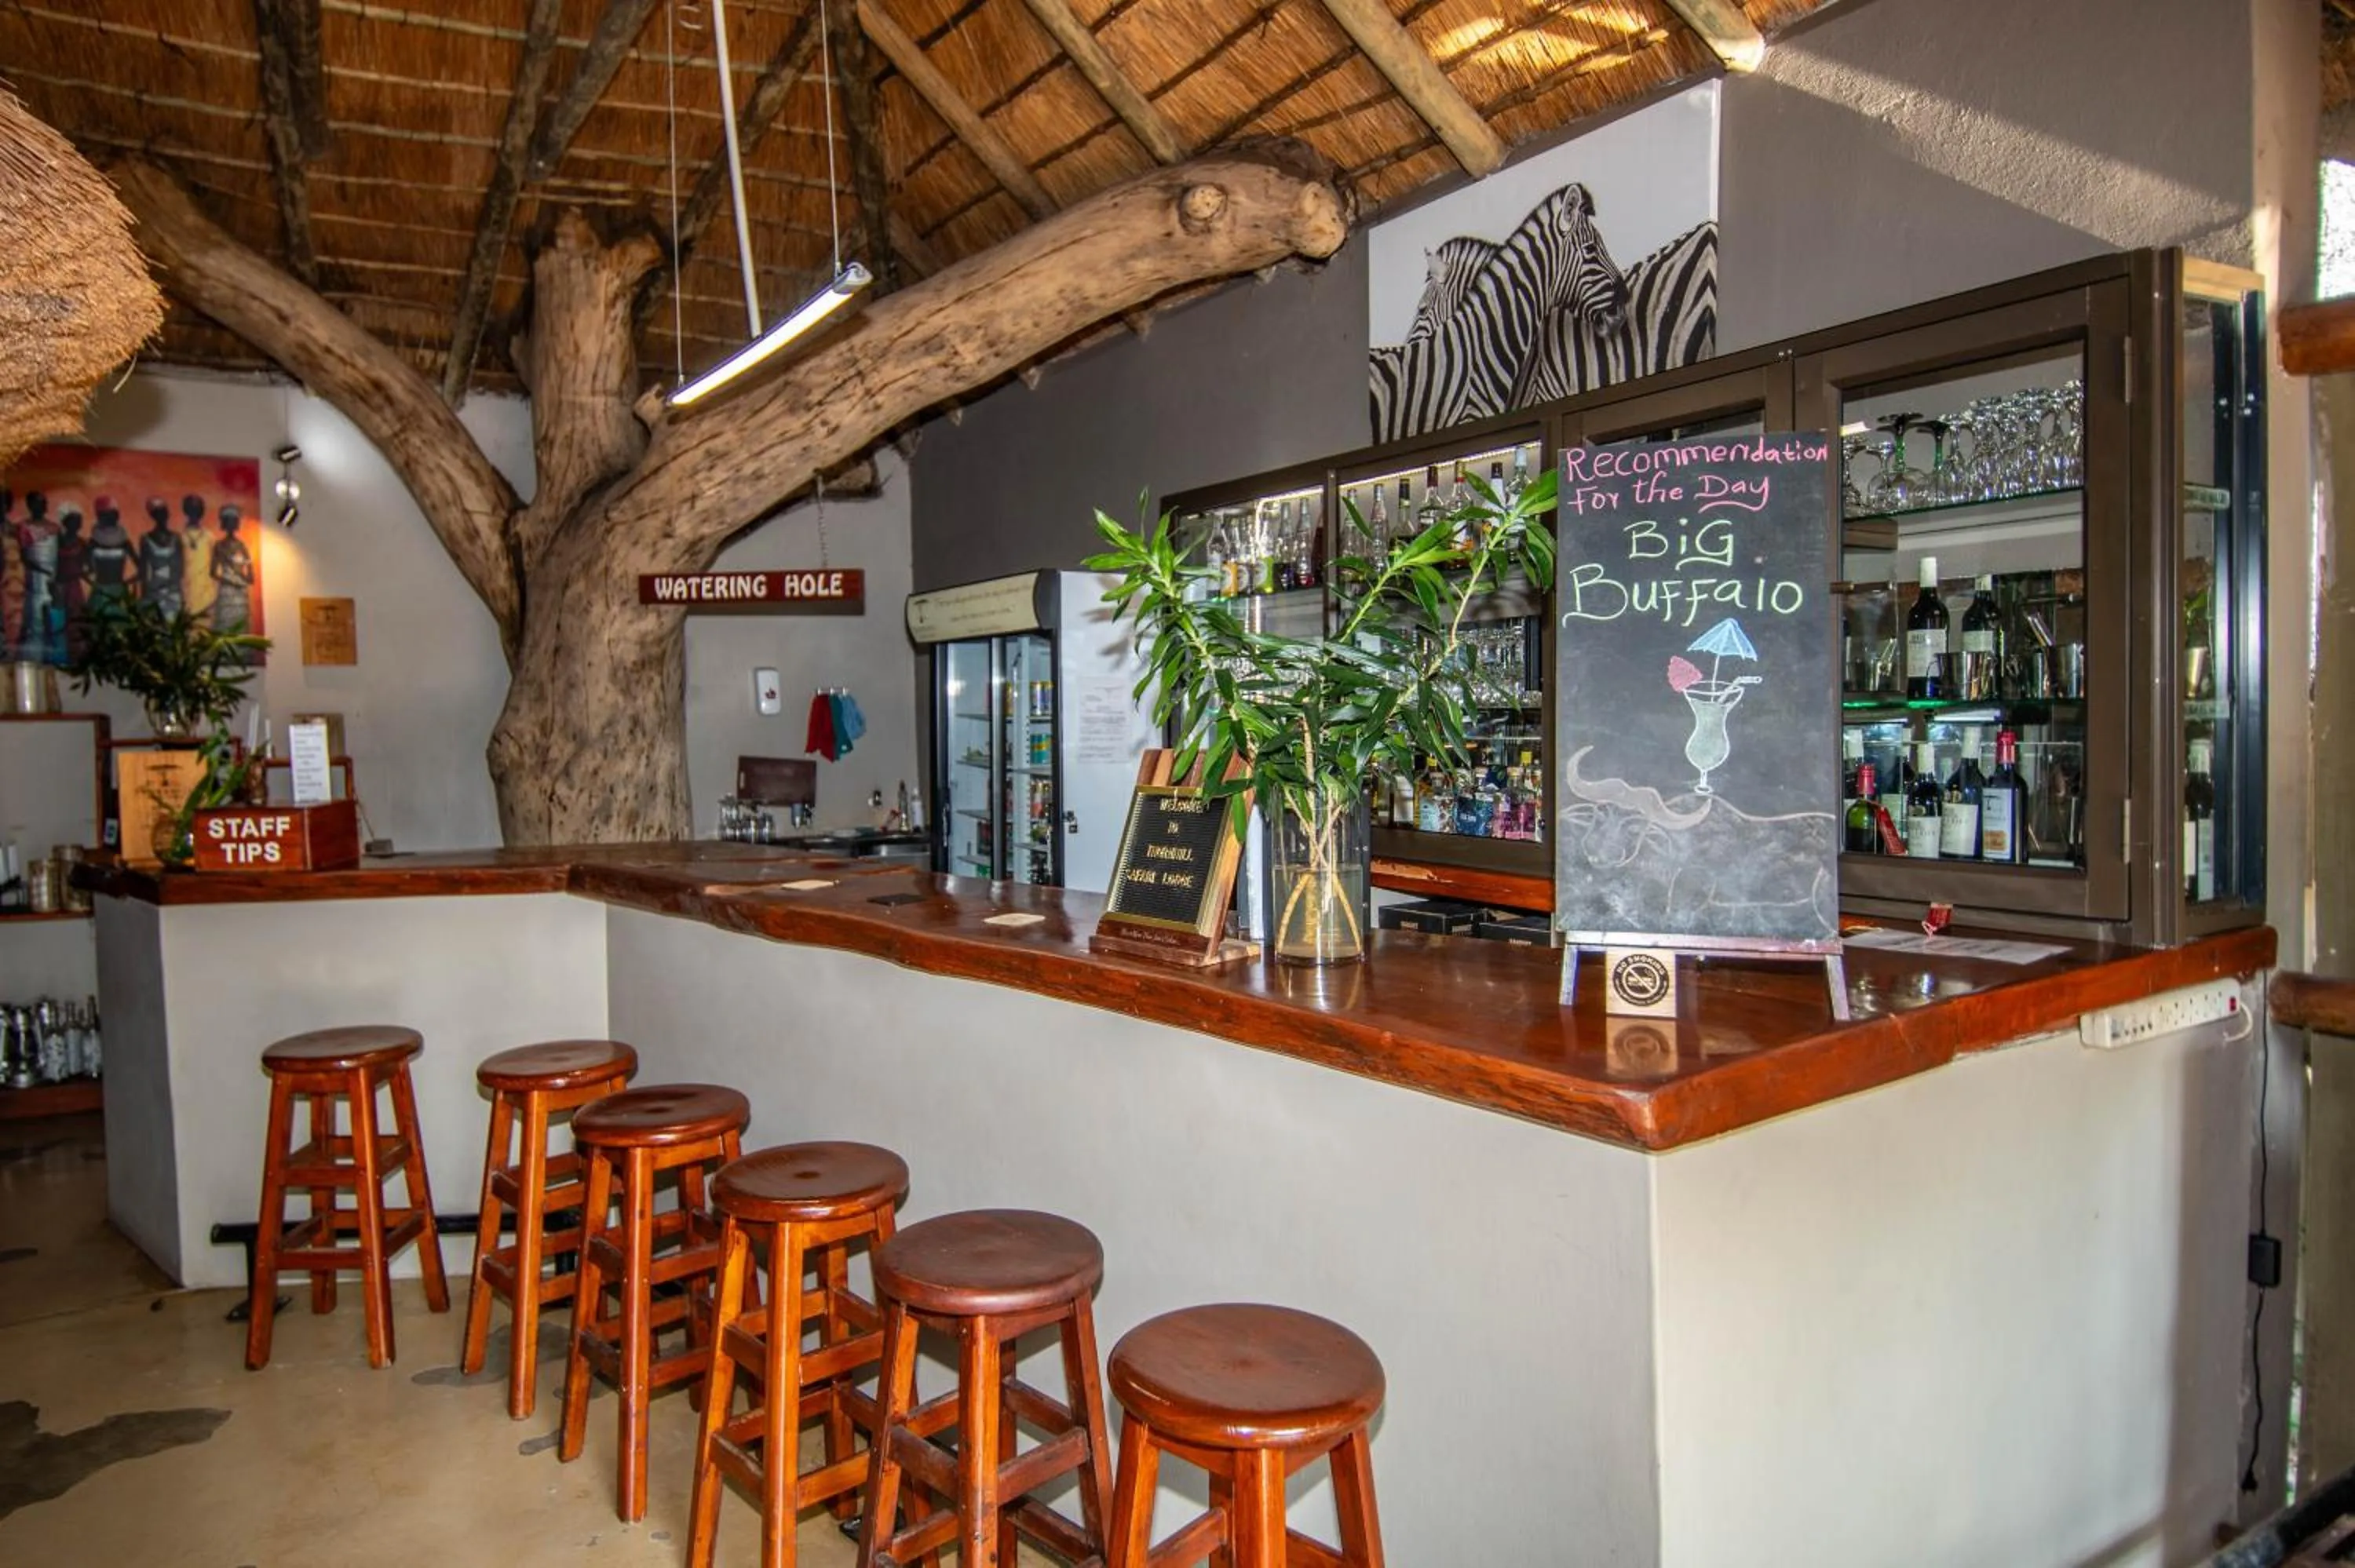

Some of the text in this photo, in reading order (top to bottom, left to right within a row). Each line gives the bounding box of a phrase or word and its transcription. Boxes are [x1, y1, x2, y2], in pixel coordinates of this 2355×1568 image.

[1566, 436, 1828, 482] Recommendation
[1568, 470, 1769, 515] For the Day
[655, 572, 843, 600] WATERING HOLE
[208, 815, 291, 839] STAFF
[220, 841, 281, 864] TIPS
[1616, 955, 1665, 975] NO SMOKING
